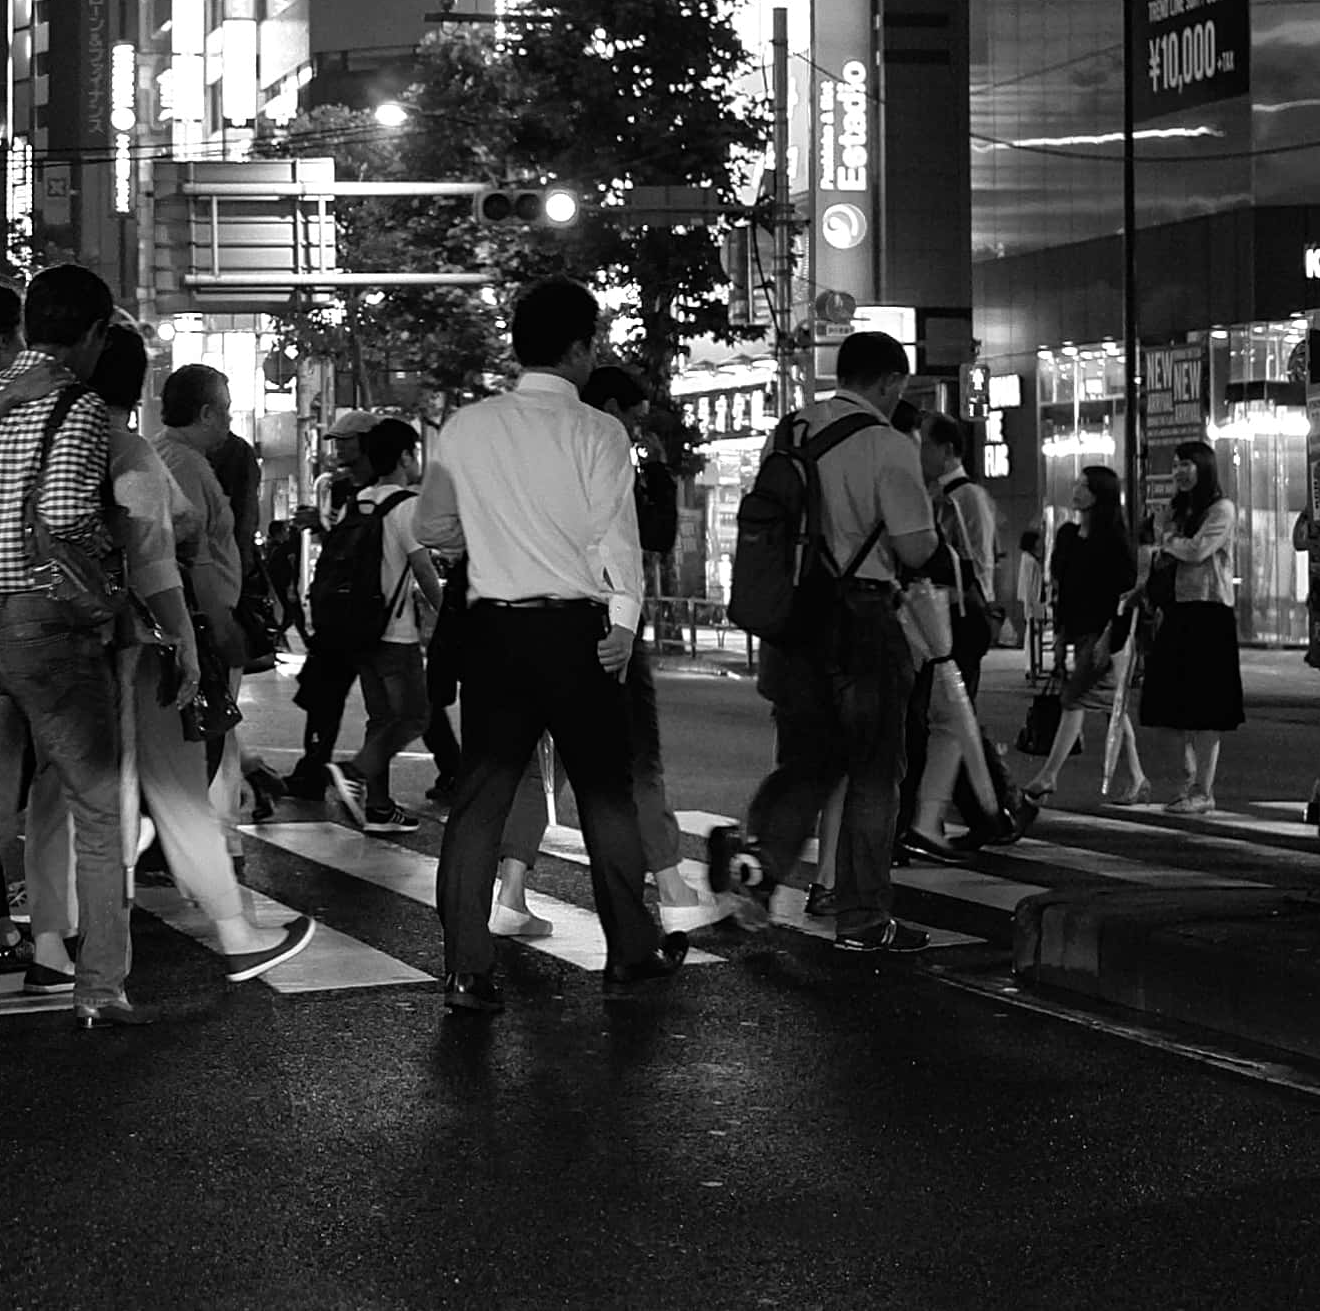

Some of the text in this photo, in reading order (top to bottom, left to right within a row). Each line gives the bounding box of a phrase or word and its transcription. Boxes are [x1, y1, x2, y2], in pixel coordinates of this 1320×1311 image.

[1148, 19, 1215, 94] ¥10,000
[836, 60, 867, 191] Estadio
[1146, 351, 1173, 390] NEW
[1174, 360, 1201, 401] NEW
